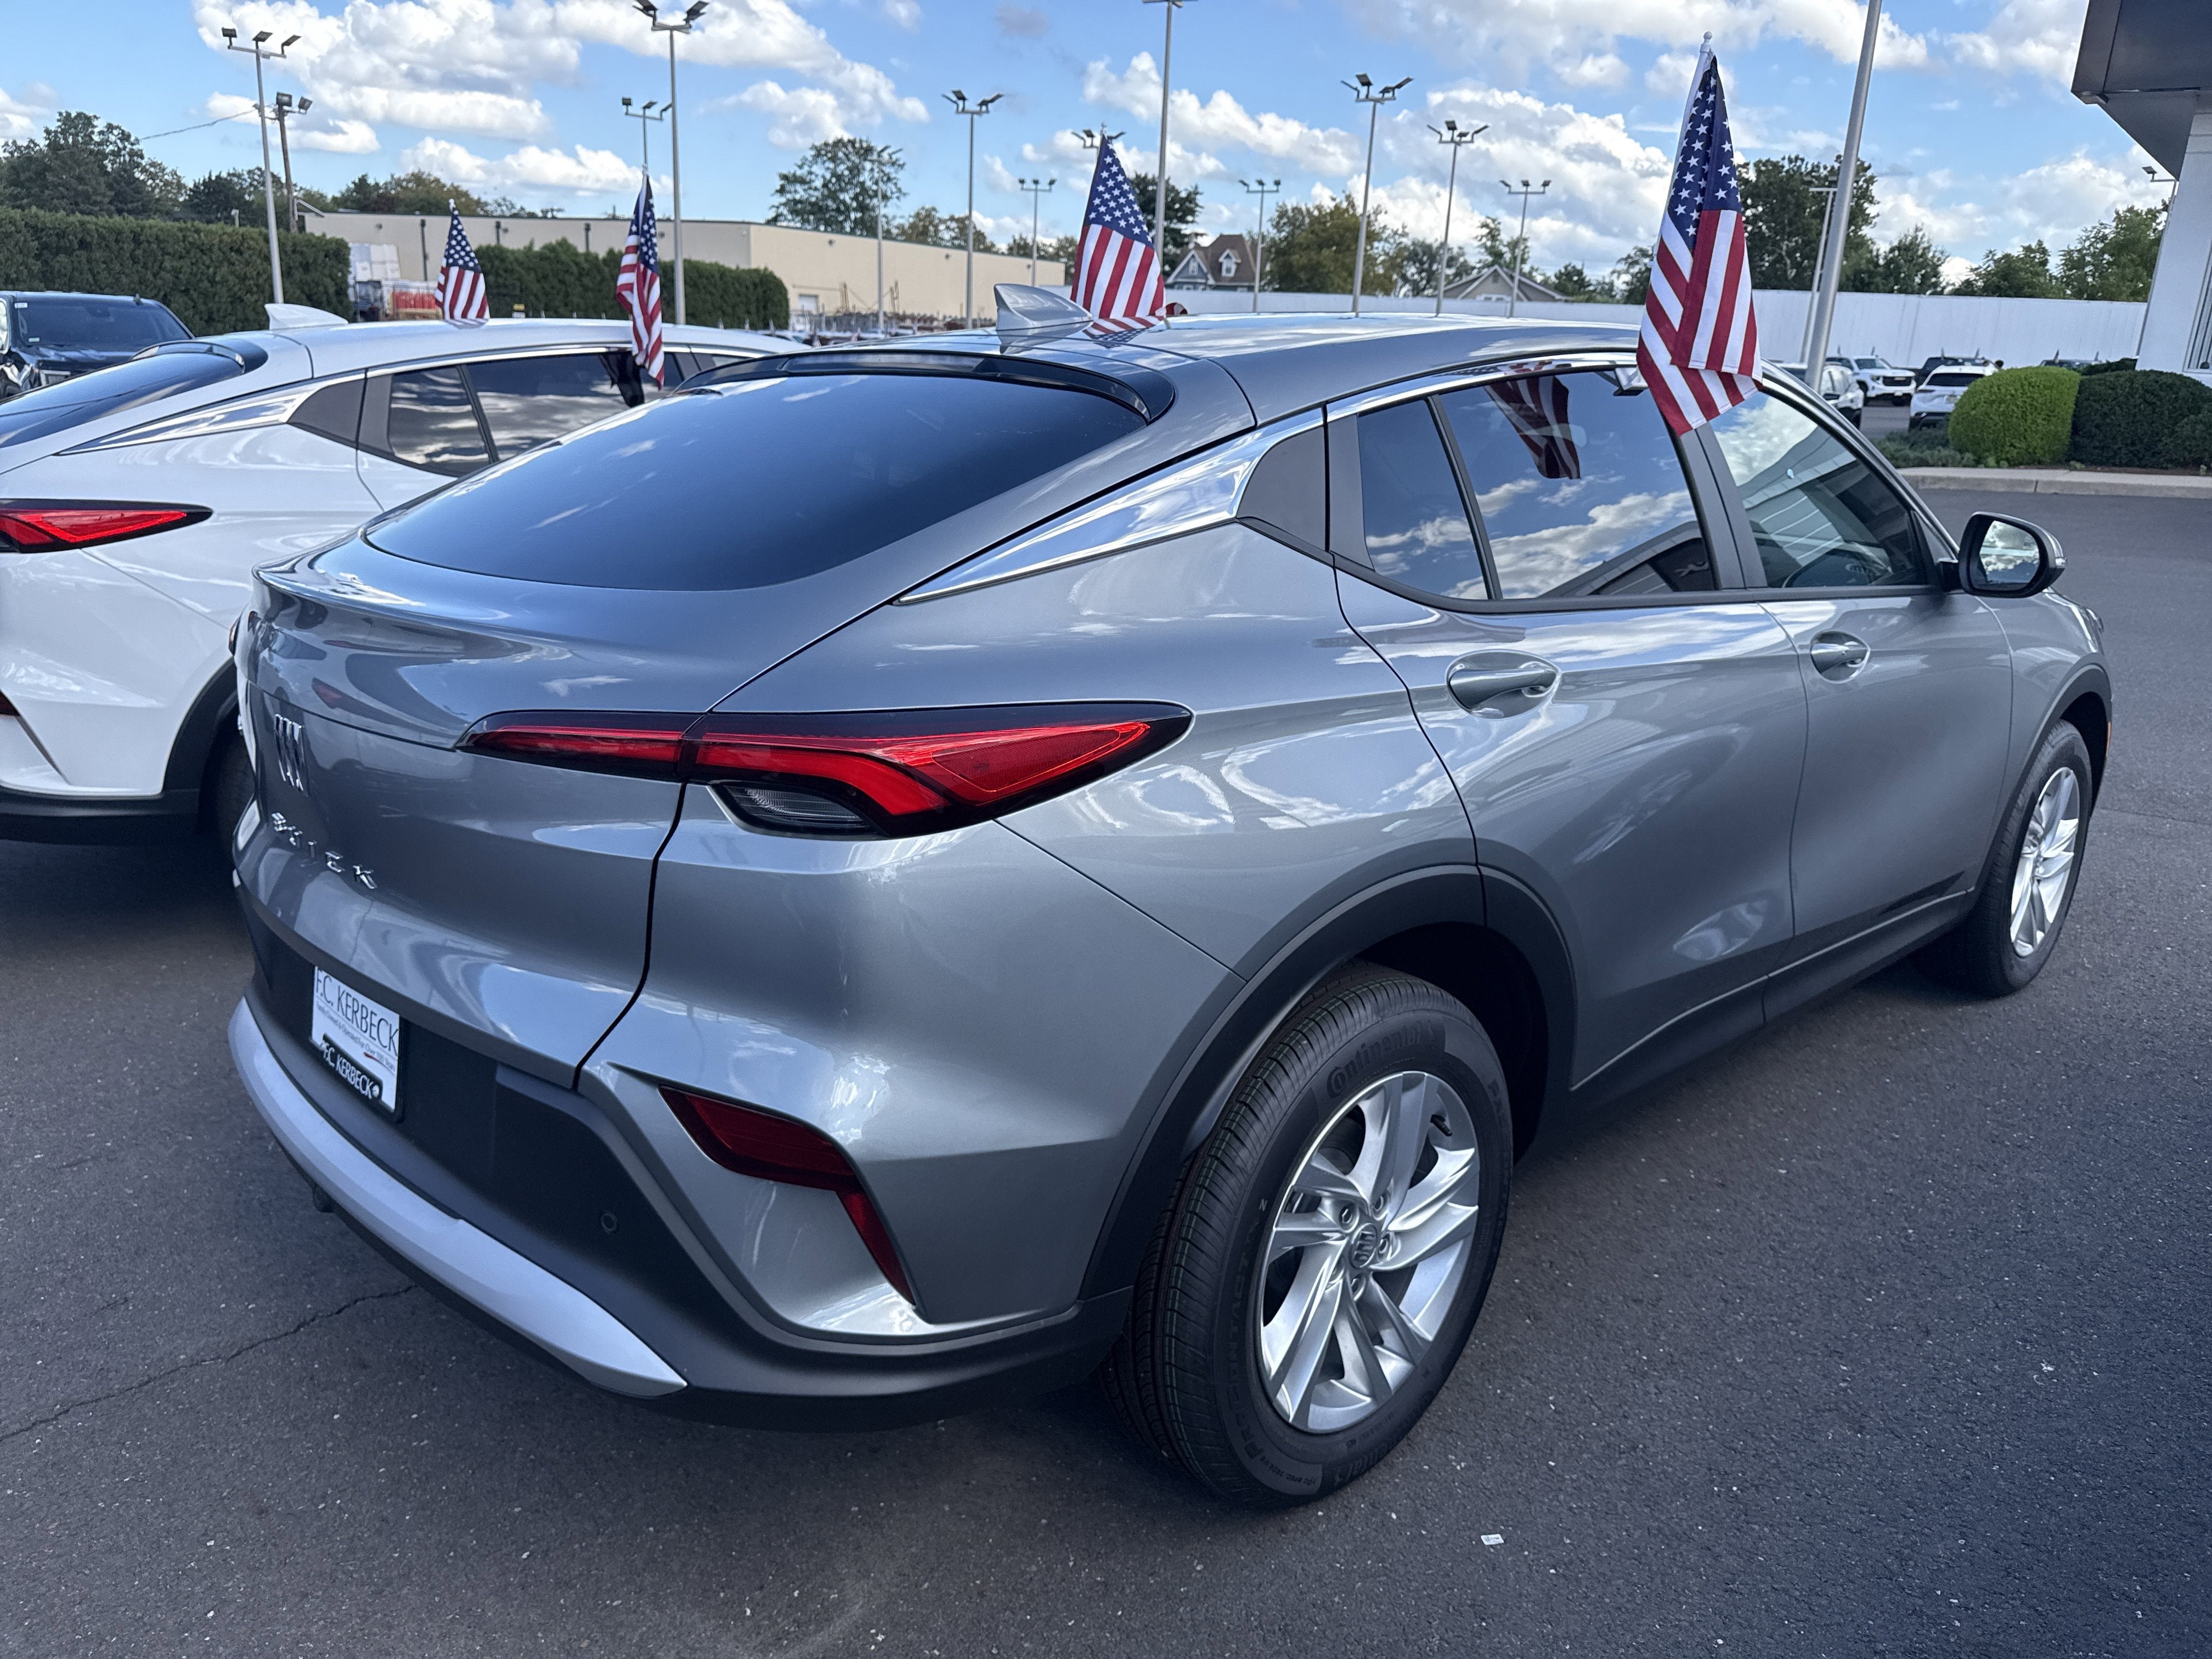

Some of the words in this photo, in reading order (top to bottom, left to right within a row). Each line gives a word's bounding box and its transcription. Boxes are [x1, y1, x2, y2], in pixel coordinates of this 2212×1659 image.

[315, 970, 334, 1007] F.C.
[337, 985, 399, 1057] KERBECK
[336, 1053, 374, 1099] KERBECK
[1327, 1020, 1422, 1098] Continental
